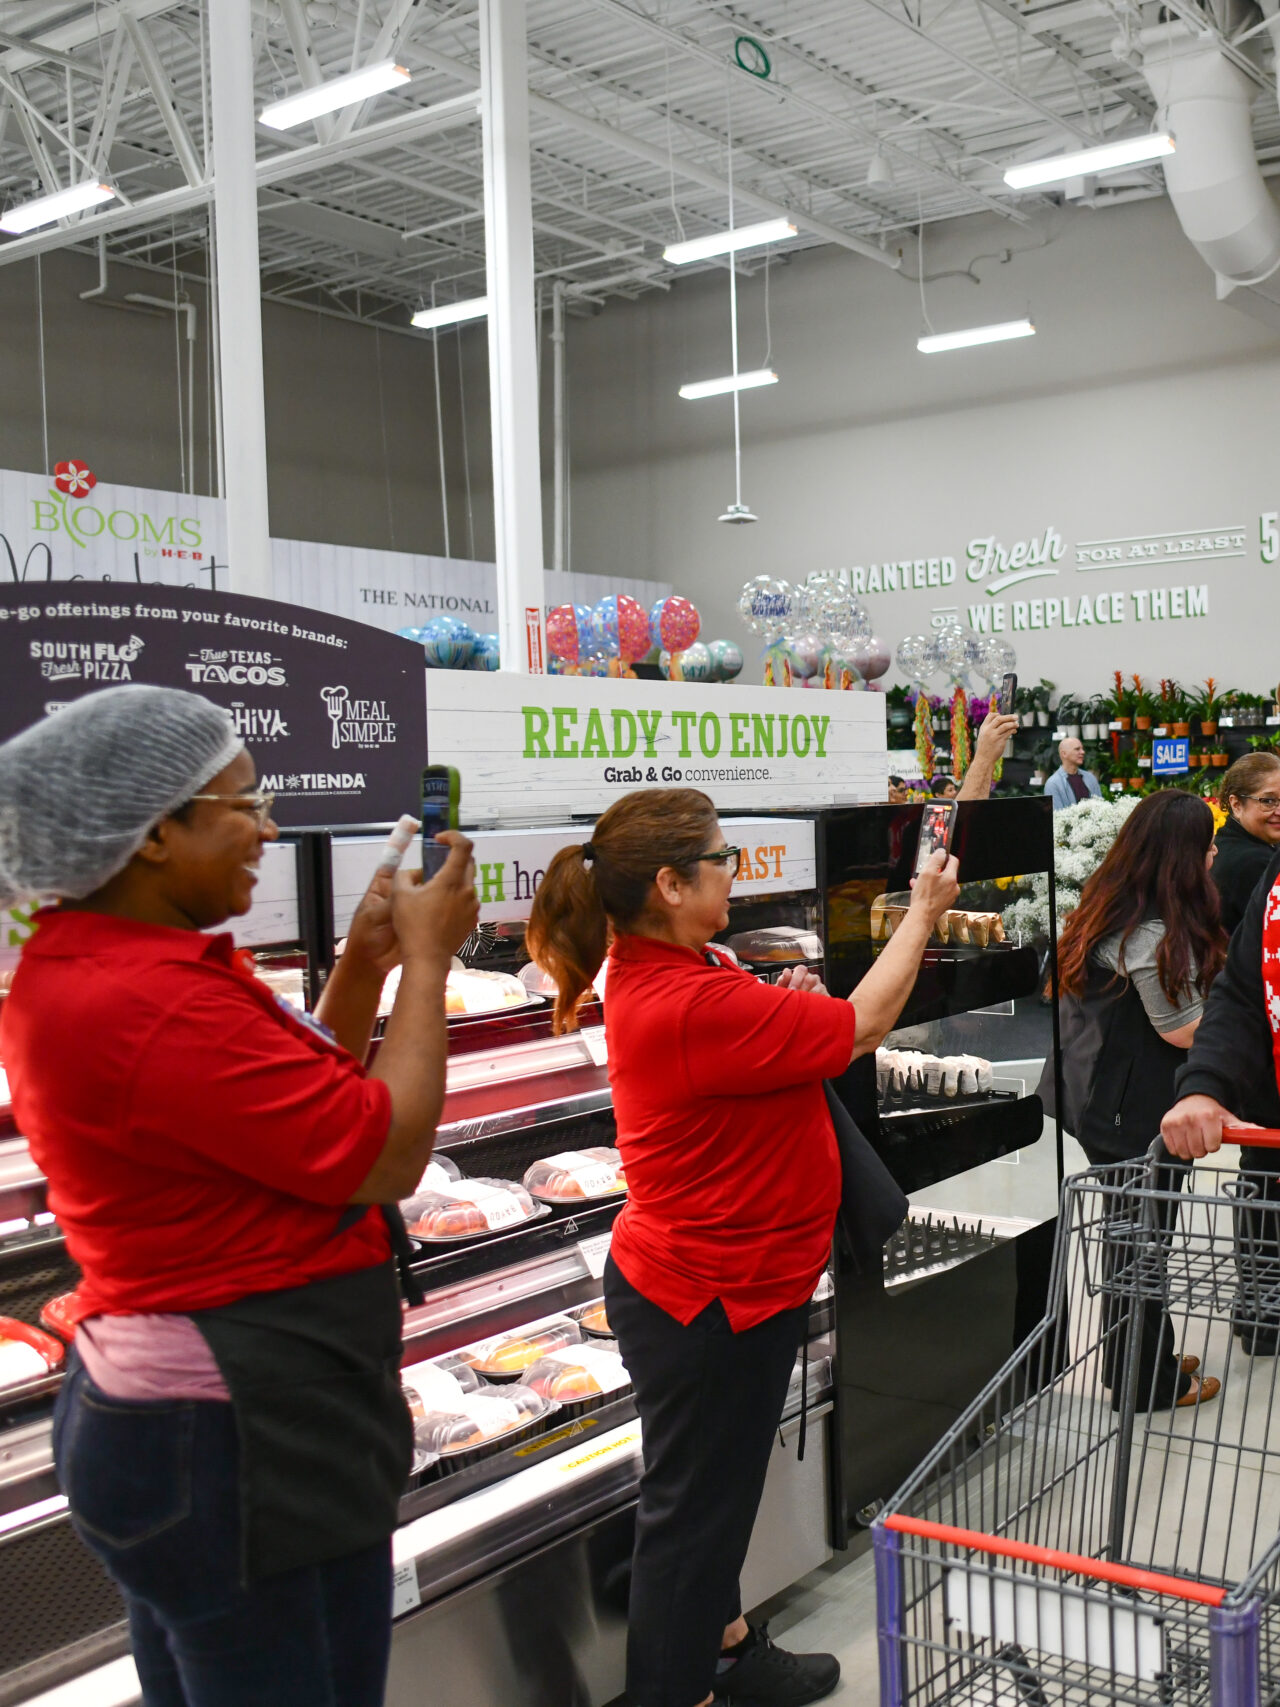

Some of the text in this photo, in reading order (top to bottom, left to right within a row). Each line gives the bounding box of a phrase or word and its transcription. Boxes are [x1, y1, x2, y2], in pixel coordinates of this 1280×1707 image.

[966, 526, 1067, 587] Fresh
[1076, 546, 1122, 563] FOR
[1126, 544, 1160, 559] AT
[1165, 534, 1247, 554] LEAST
[1260, 512, 1280, 564] 5
[360, 588, 494, 614] THE NATIONAL
[967, 602, 1006, 634] WE
[1012, 591, 1125, 631] REPLACE
[1131, 585, 1209, 621] THEM
[45, 602, 131, 620] offerings
[135, 604, 178, 620] from
[182, 610, 220, 625] your
[224, 613, 289, 635] favorite
[292, 625, 348, 649] brands:
[30, 641, 91, 660] SOUTH
[201, 649, 271, 664] True TEXAS
[41, 661, 132, 680] Fresh PIZZA
[185, 663, 286, 686] TACOS
[345, 700, 390, 720] MEAL
[341, 722, 396, 742] SIMPLE
[521, 706, 830, 759] READY TO ENJOY
[1156, 744, 1186, 764] SALE!
[260, 773, 366, 790] MI TIENDA
[604, 765, 772, 782] Grab & Go convenience.
